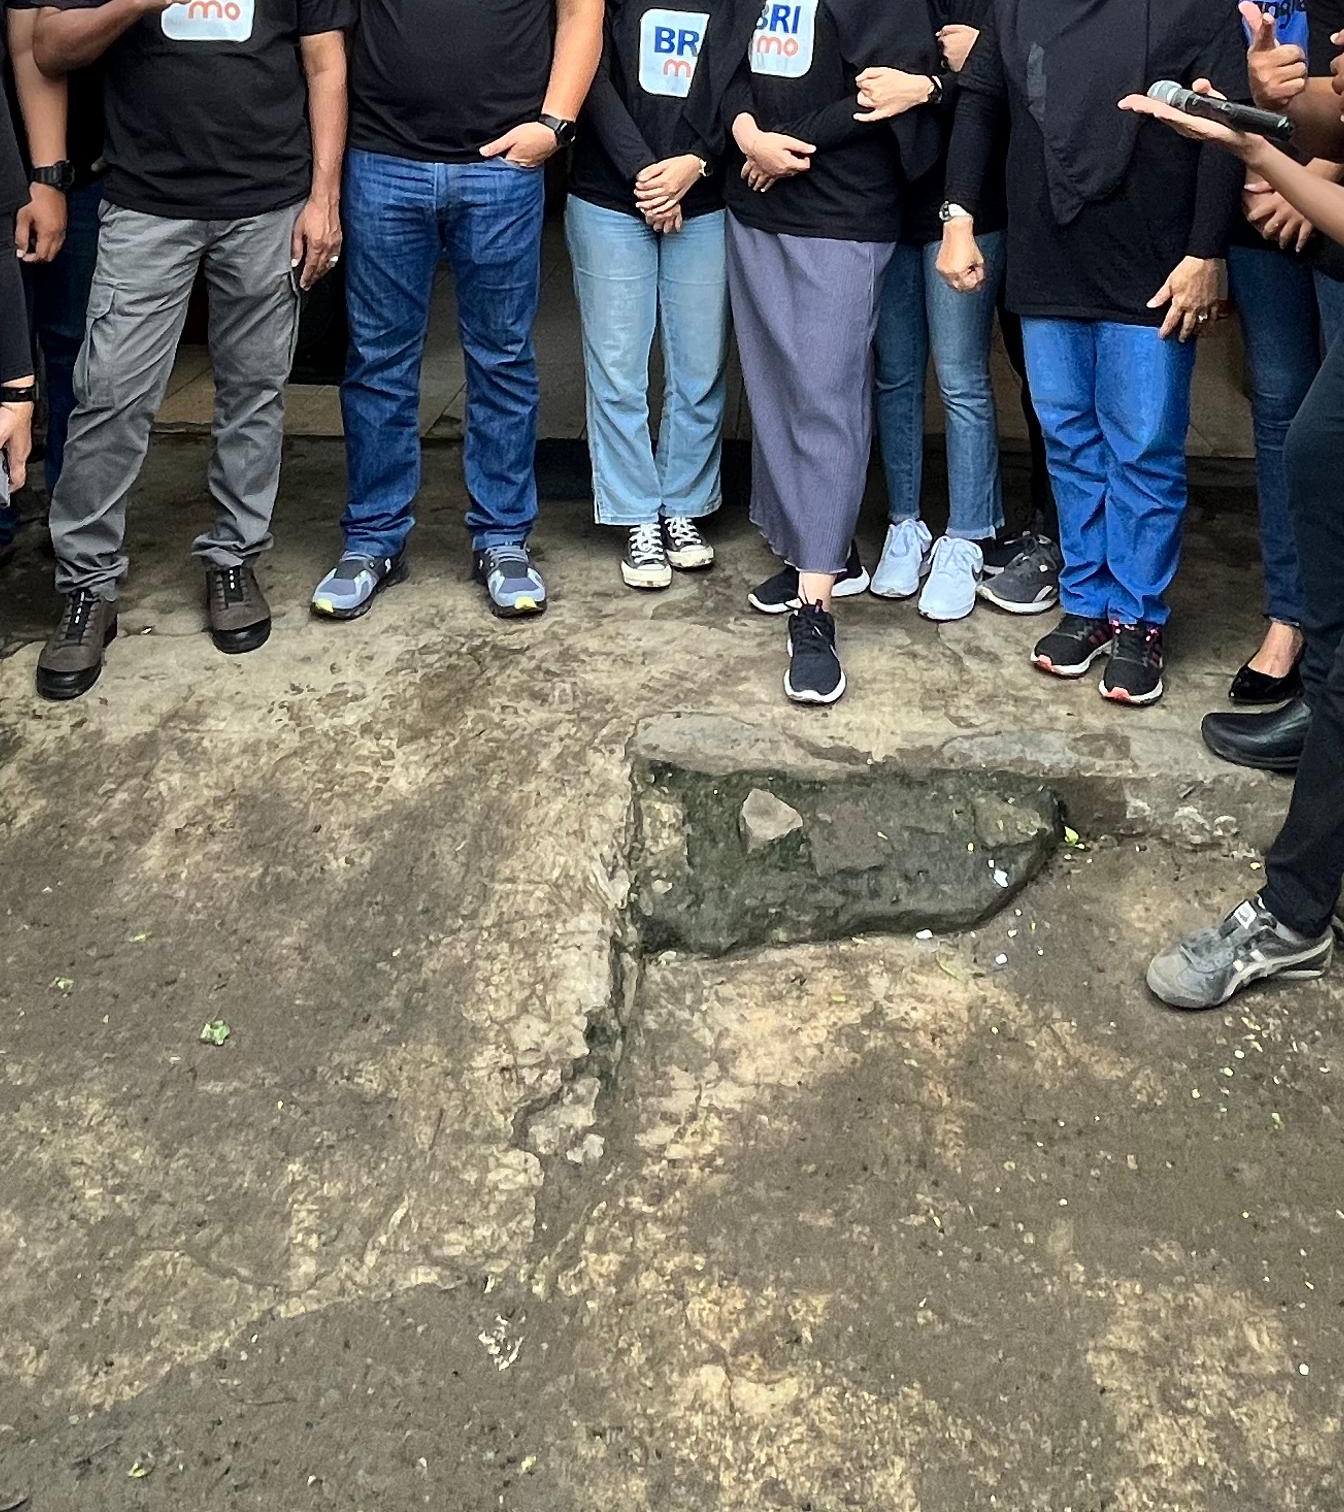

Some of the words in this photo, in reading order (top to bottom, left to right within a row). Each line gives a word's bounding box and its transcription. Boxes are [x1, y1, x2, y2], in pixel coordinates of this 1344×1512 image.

[188, 0, 241, 21] mo
[653, 26, 700, 57] BR
[756, 35, 799, 57] mo
[663, 58, 692, 78] m
